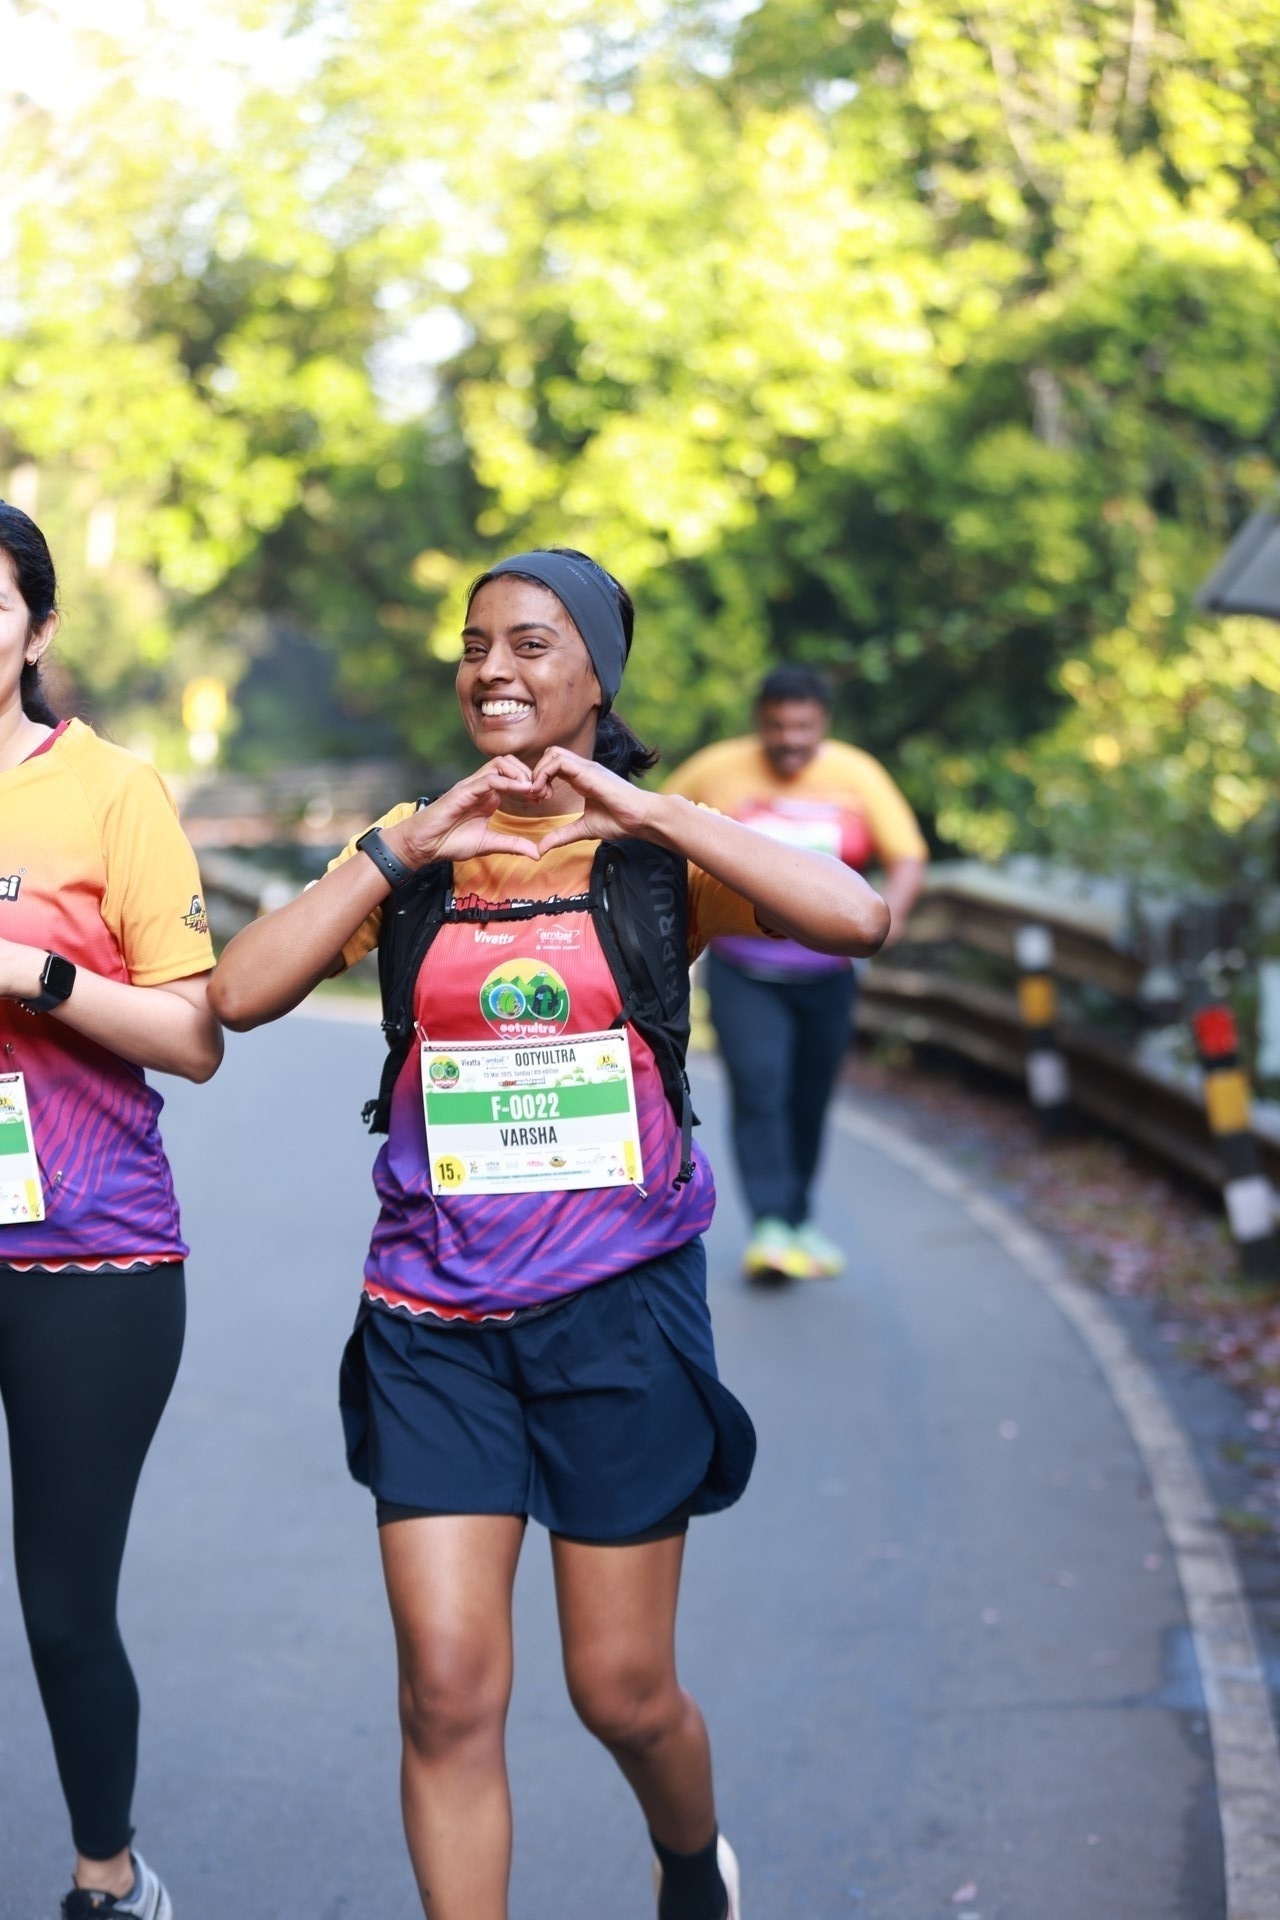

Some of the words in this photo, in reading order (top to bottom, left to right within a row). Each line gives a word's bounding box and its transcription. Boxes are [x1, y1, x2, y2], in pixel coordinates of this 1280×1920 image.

[647, 857, 678, 1005] KIPRUN
[499, 1022, 557, 1035] ootyultra
[515, 1048, 577, 1067] OOTYULTRA
[490, 1092, 560, 1121] F-0022
[500, 1125, 558, 1147] VARSHA
[438, 1163, 455, 1181] 15
